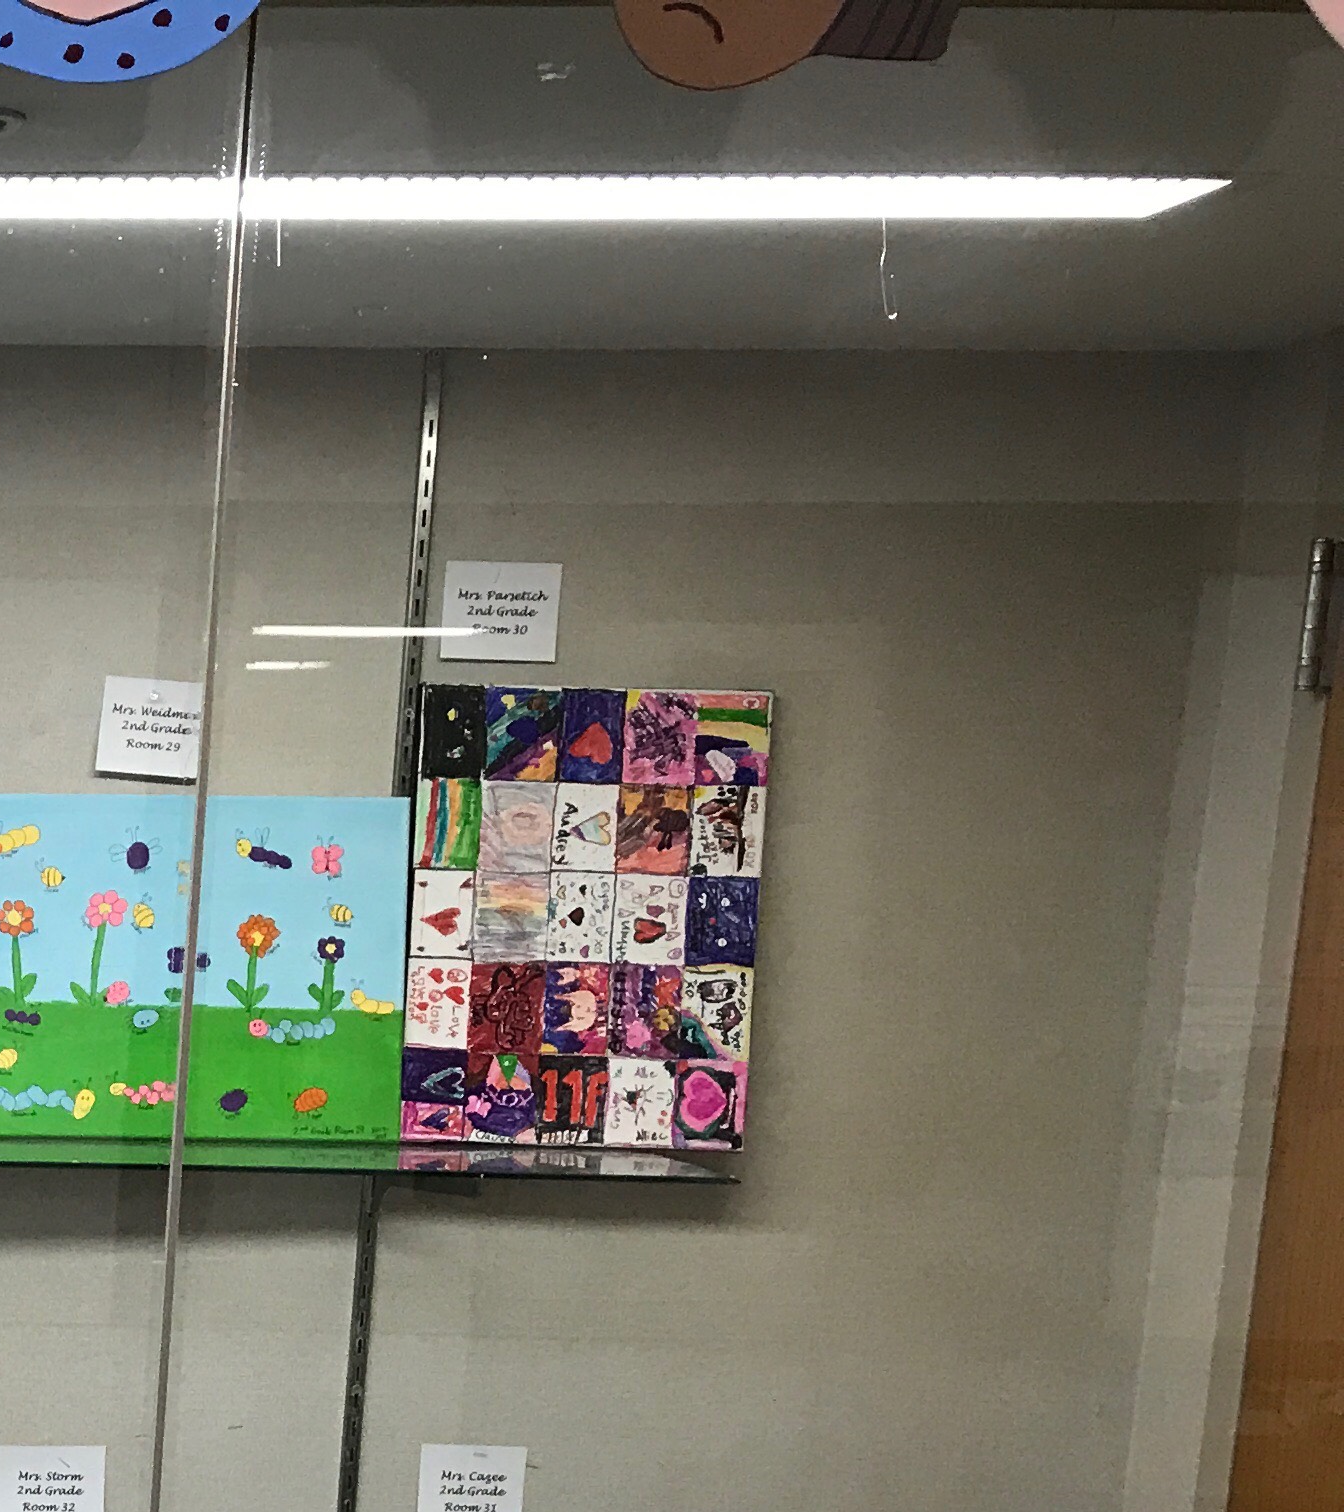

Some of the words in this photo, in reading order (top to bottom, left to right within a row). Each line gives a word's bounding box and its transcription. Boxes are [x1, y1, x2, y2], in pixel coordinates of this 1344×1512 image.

[467, 605, 494, 616] 2nd
[495, 605, 538, 617] Grade
[512, 624, 528, 636] 30
[121, 719, 149, 732] 2nd
[150, 722, 192, 736] Grade
[126, 738, 165, 752] Room
[166, 741, 181, 752] 29
[553, 801, 579, 867] Audrey
[45, 1470, 84, 1482] Storm
[17, 1485, 43, 1496] 2nd
[44, 1485, 84, 1496] Grade
[439, 1484, 466, 1495] 2nd
[467, 1485, 507, 1497] Grade
[22, 1502, 60, 1512] Room
[61, 1502, 76, 1512] 32
[444, 1502, 481, 1512] Room
[483, 1503, 497, 1512] 31
